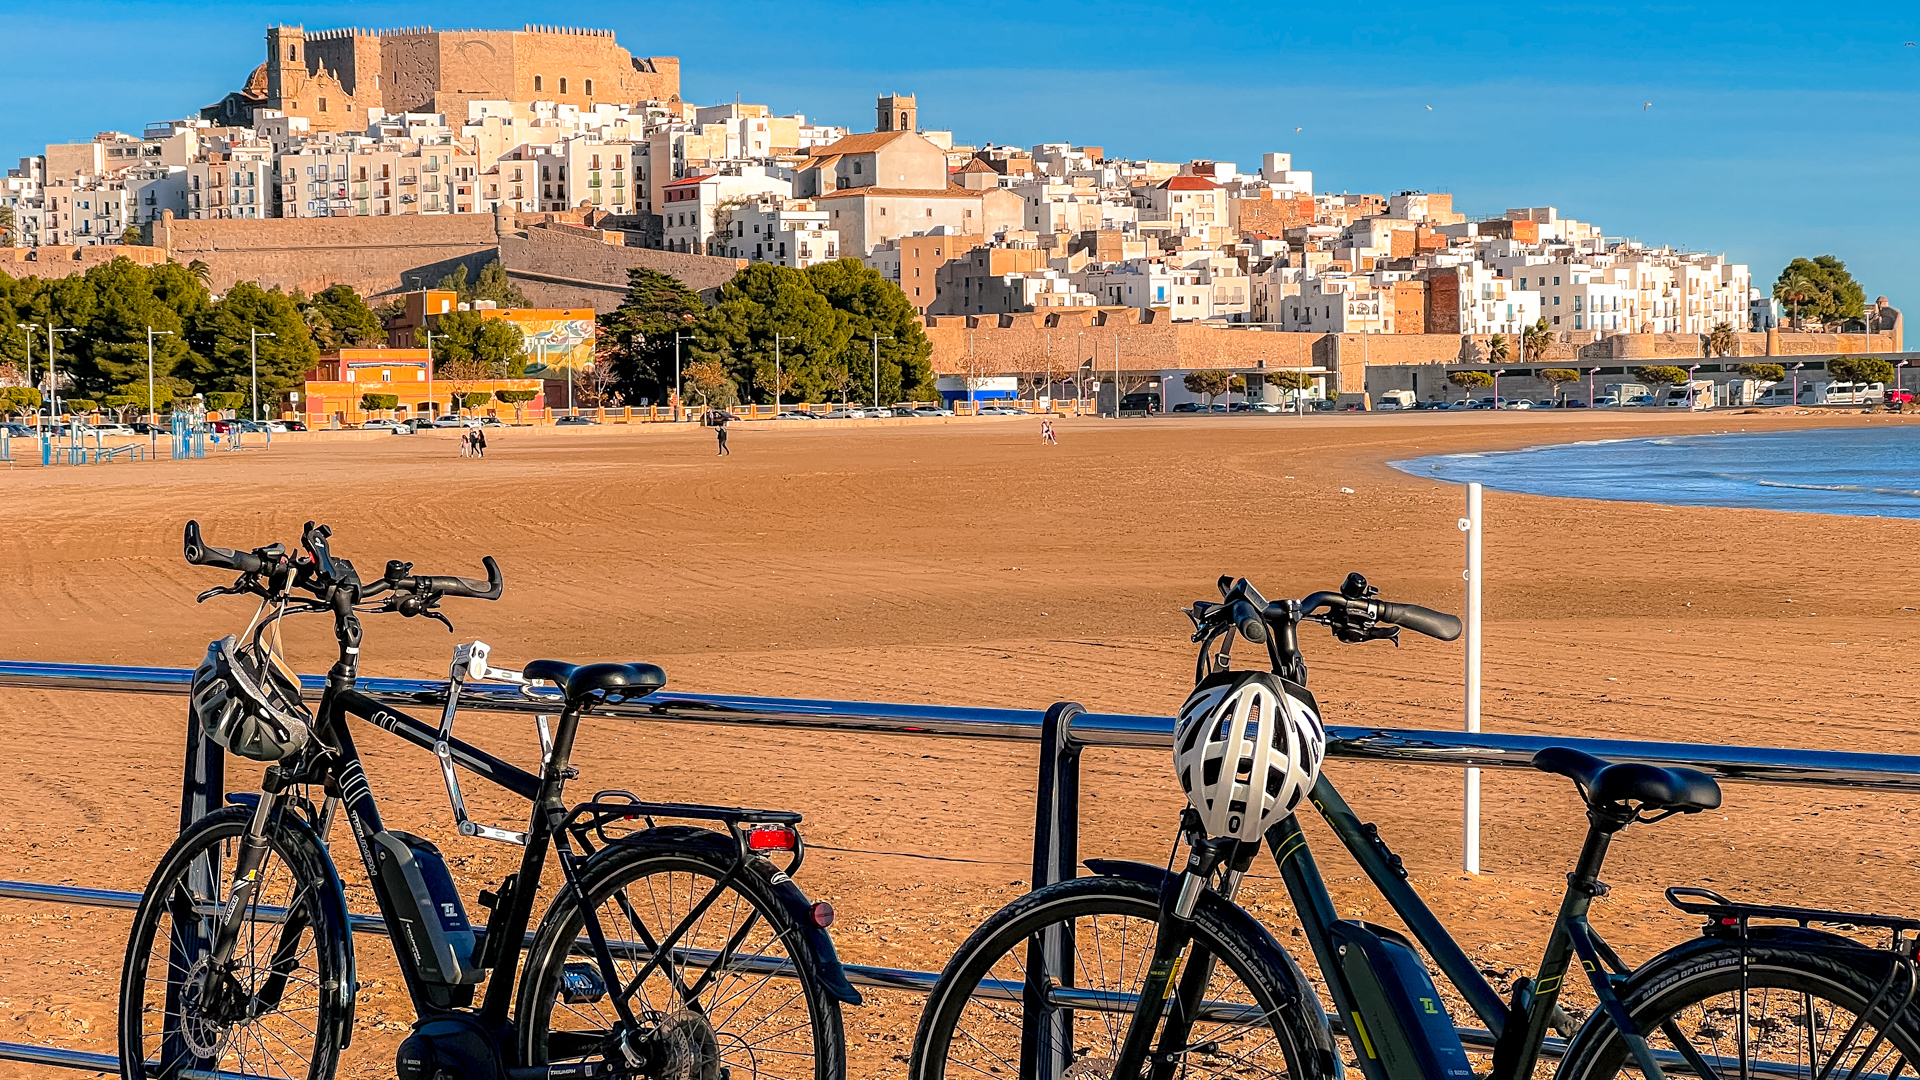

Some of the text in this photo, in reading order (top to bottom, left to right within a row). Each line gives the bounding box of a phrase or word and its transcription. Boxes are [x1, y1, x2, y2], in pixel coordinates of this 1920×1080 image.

[351, 809, 378, 876] TRIUMPH
[1217, 931, 1248, 960] OPTIMA
[1246, 959, 1268, 984] SAFE
[1680, 961, 1716, 978] OPTIMA
[1717, 957, 1741, 967] SAF
